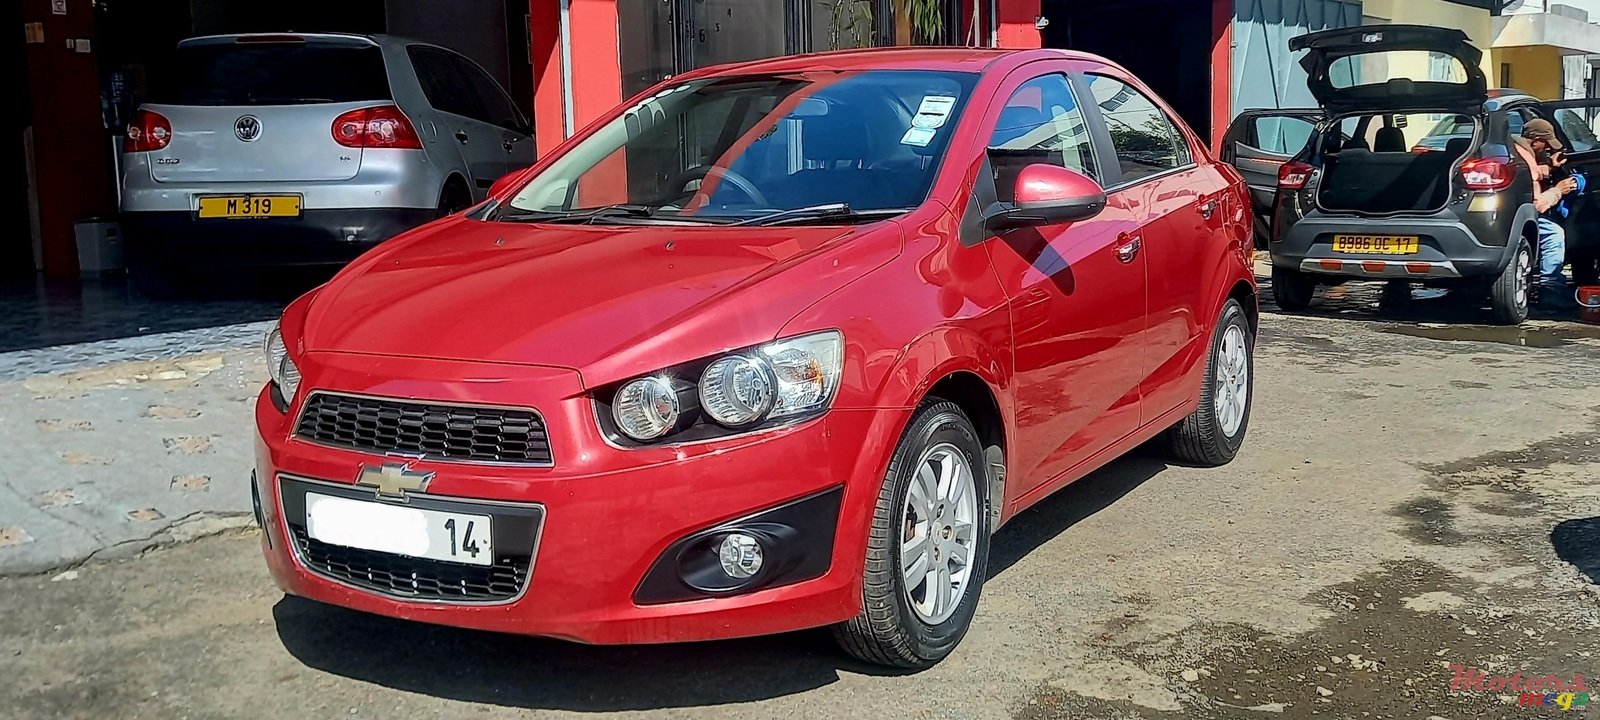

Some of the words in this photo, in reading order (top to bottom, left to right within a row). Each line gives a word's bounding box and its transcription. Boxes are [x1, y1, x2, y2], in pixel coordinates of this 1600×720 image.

[699, 28, 706, 43] 6
[226, 199, 237, 215] M
[242, 199, 272, 214] 319
[1339, 236, 1371, 250] 8986
[1395, 237, 1411, 251] 17
[444, 518, 480, 558] 14
